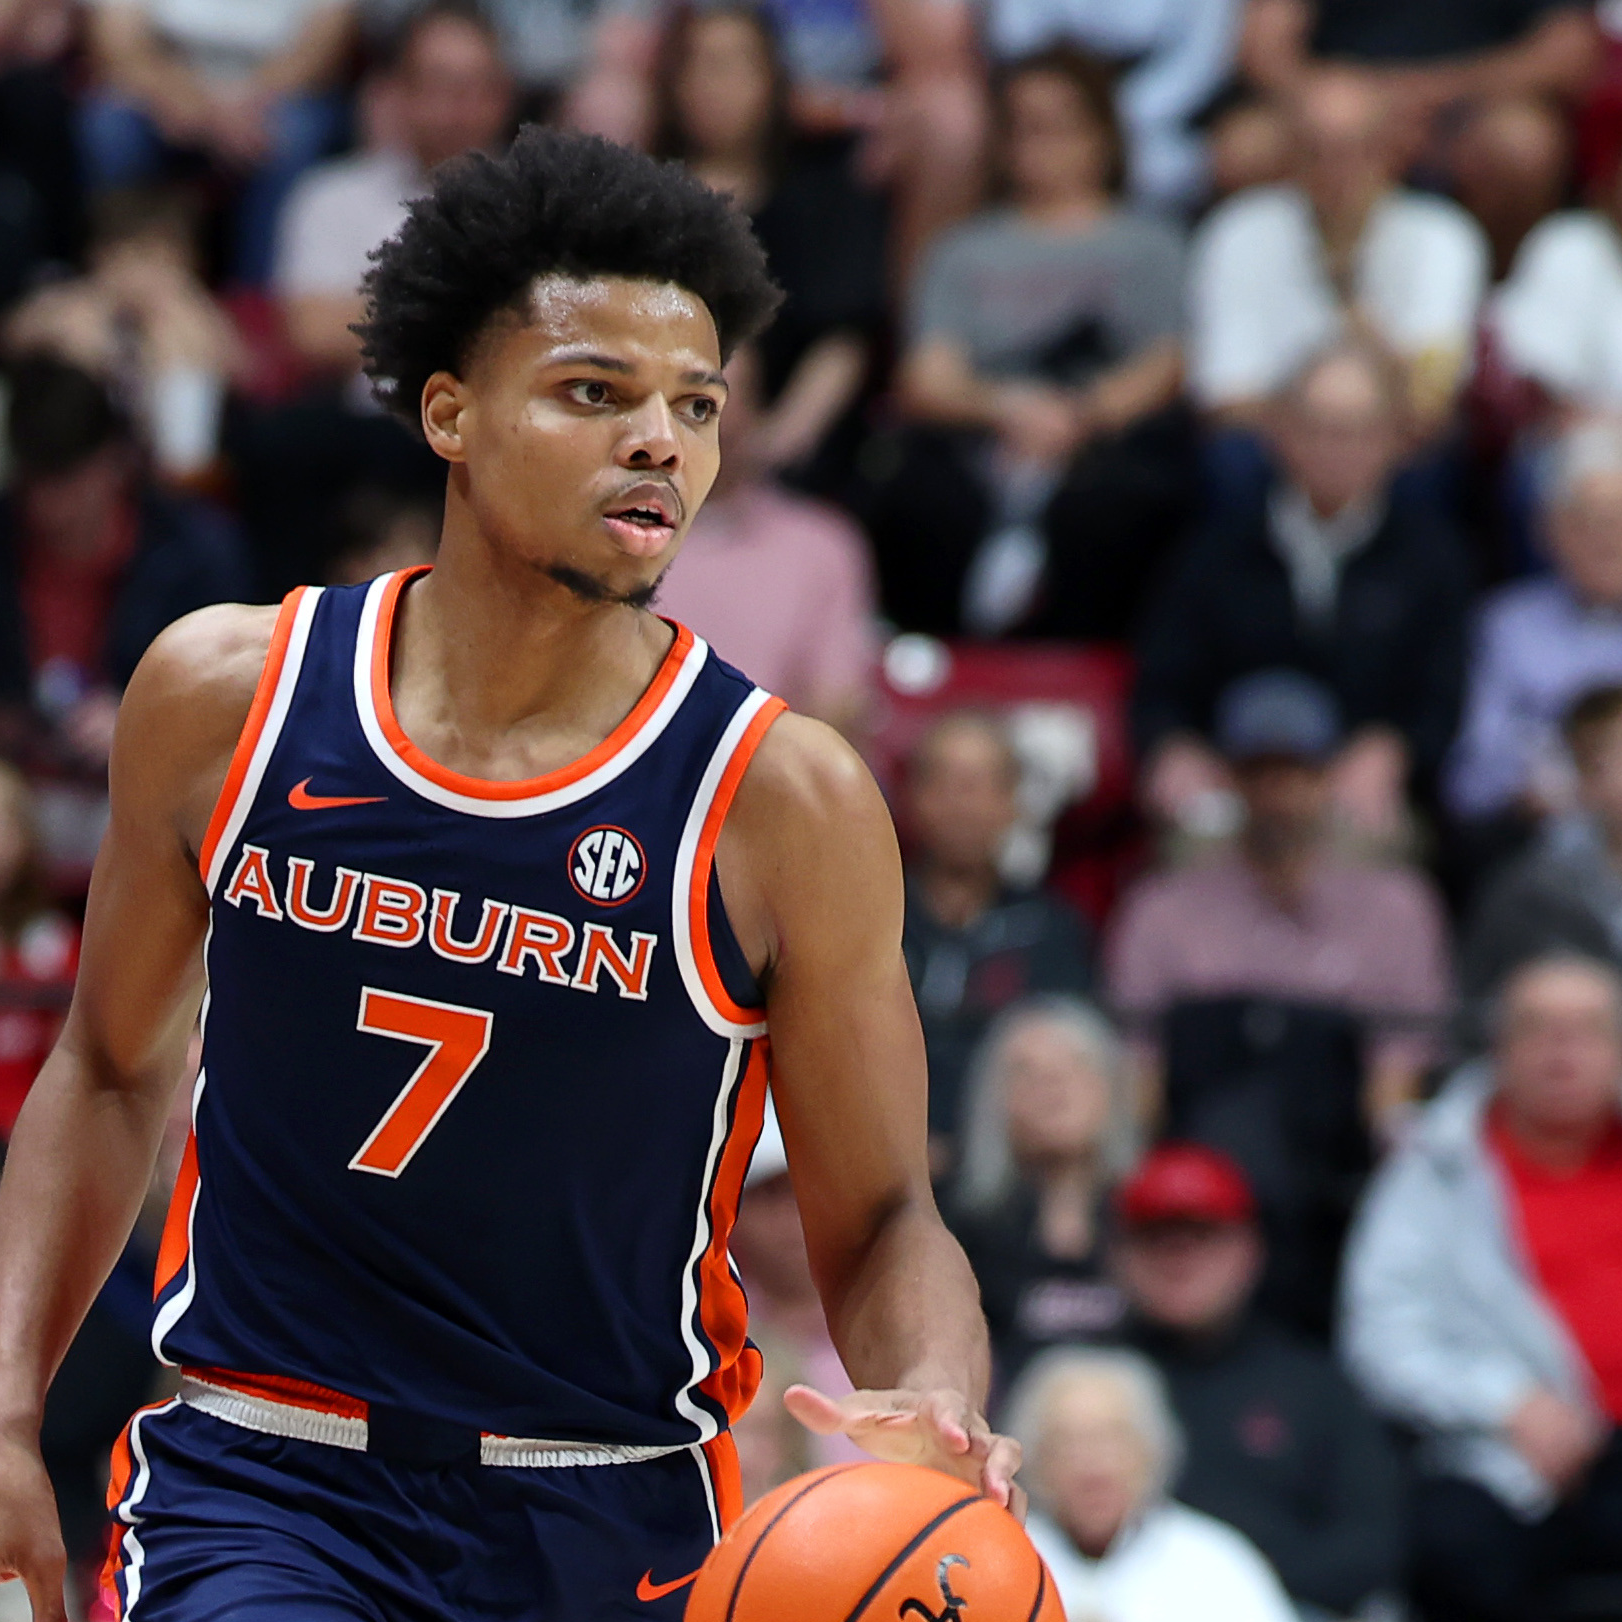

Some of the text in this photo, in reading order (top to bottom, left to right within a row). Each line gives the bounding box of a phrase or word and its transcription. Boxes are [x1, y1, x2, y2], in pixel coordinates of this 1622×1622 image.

[226, 844, 657, 1000] AUBURN
[574, 831, 640, 899] SEC
[348, 986, 493, 1178] 7
